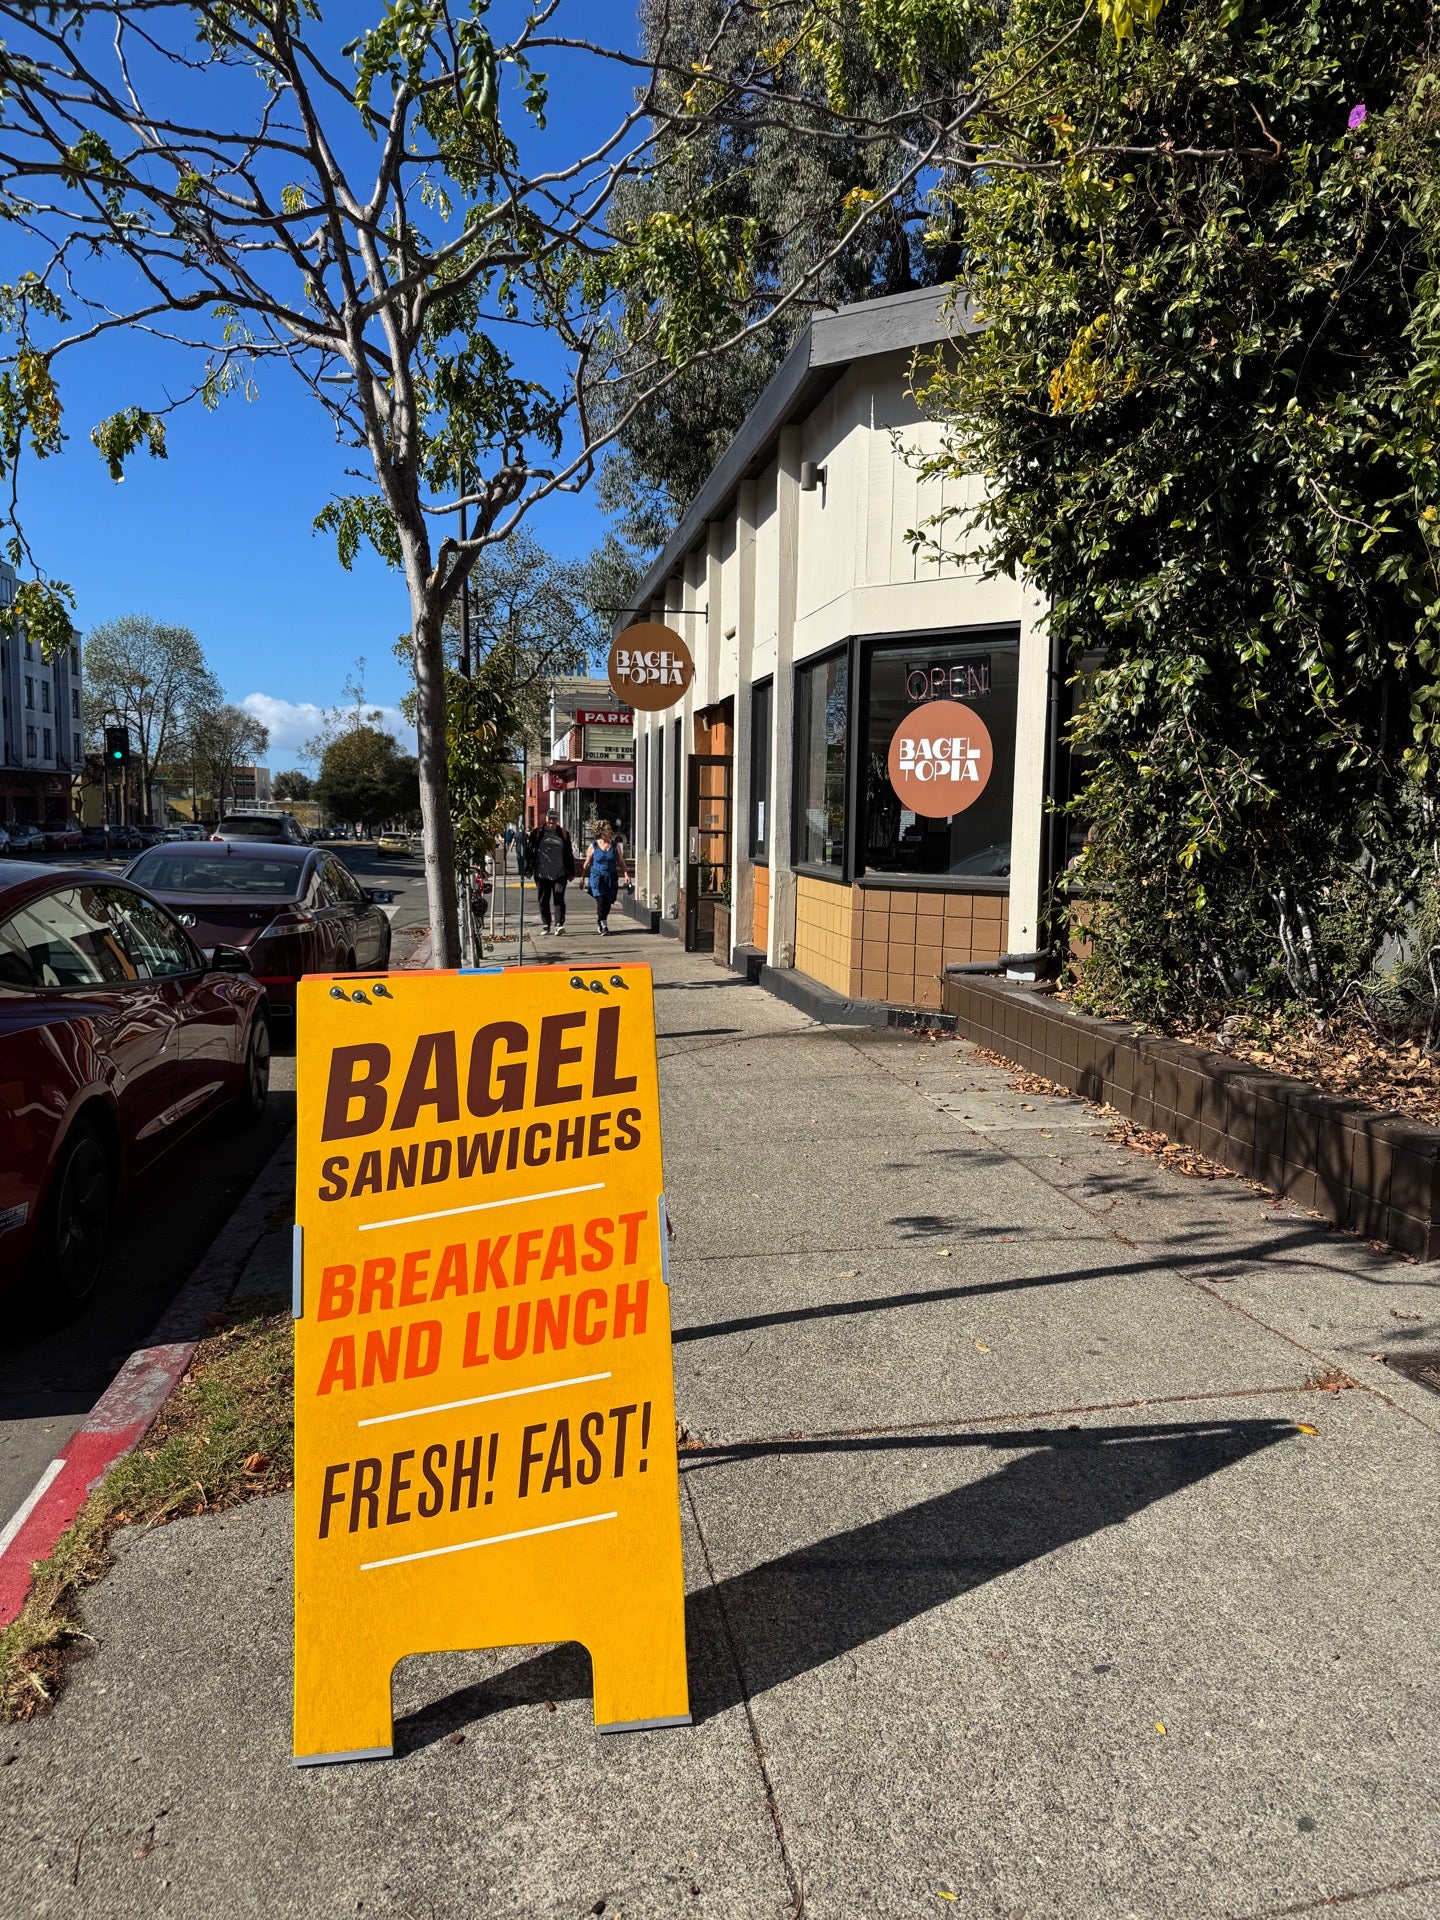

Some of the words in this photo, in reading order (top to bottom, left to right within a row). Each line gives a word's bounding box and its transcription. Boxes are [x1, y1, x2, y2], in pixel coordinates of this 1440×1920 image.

[616, 650, 684, 668] BAGEL
[616, 667, 684, 685] TOPIA
[906, 664, 990, 700] OPEN
[899, 737, 981, 760] BAGEL
[899, 760, 980, 782] TOPIA
[320, 1006, 638, 1142] BAGEL
[318, 1107, 642, 1202] SANDWICHES
[317, 1210, 648, 1323] BREAKFAST
[316, 1319, 443, 1397] AND
[462, 1279, 650, 1369] LUNCH
[318, 1432, 499, 1540] FRESH!
[518, 1401, 652, 1499] FAST!
